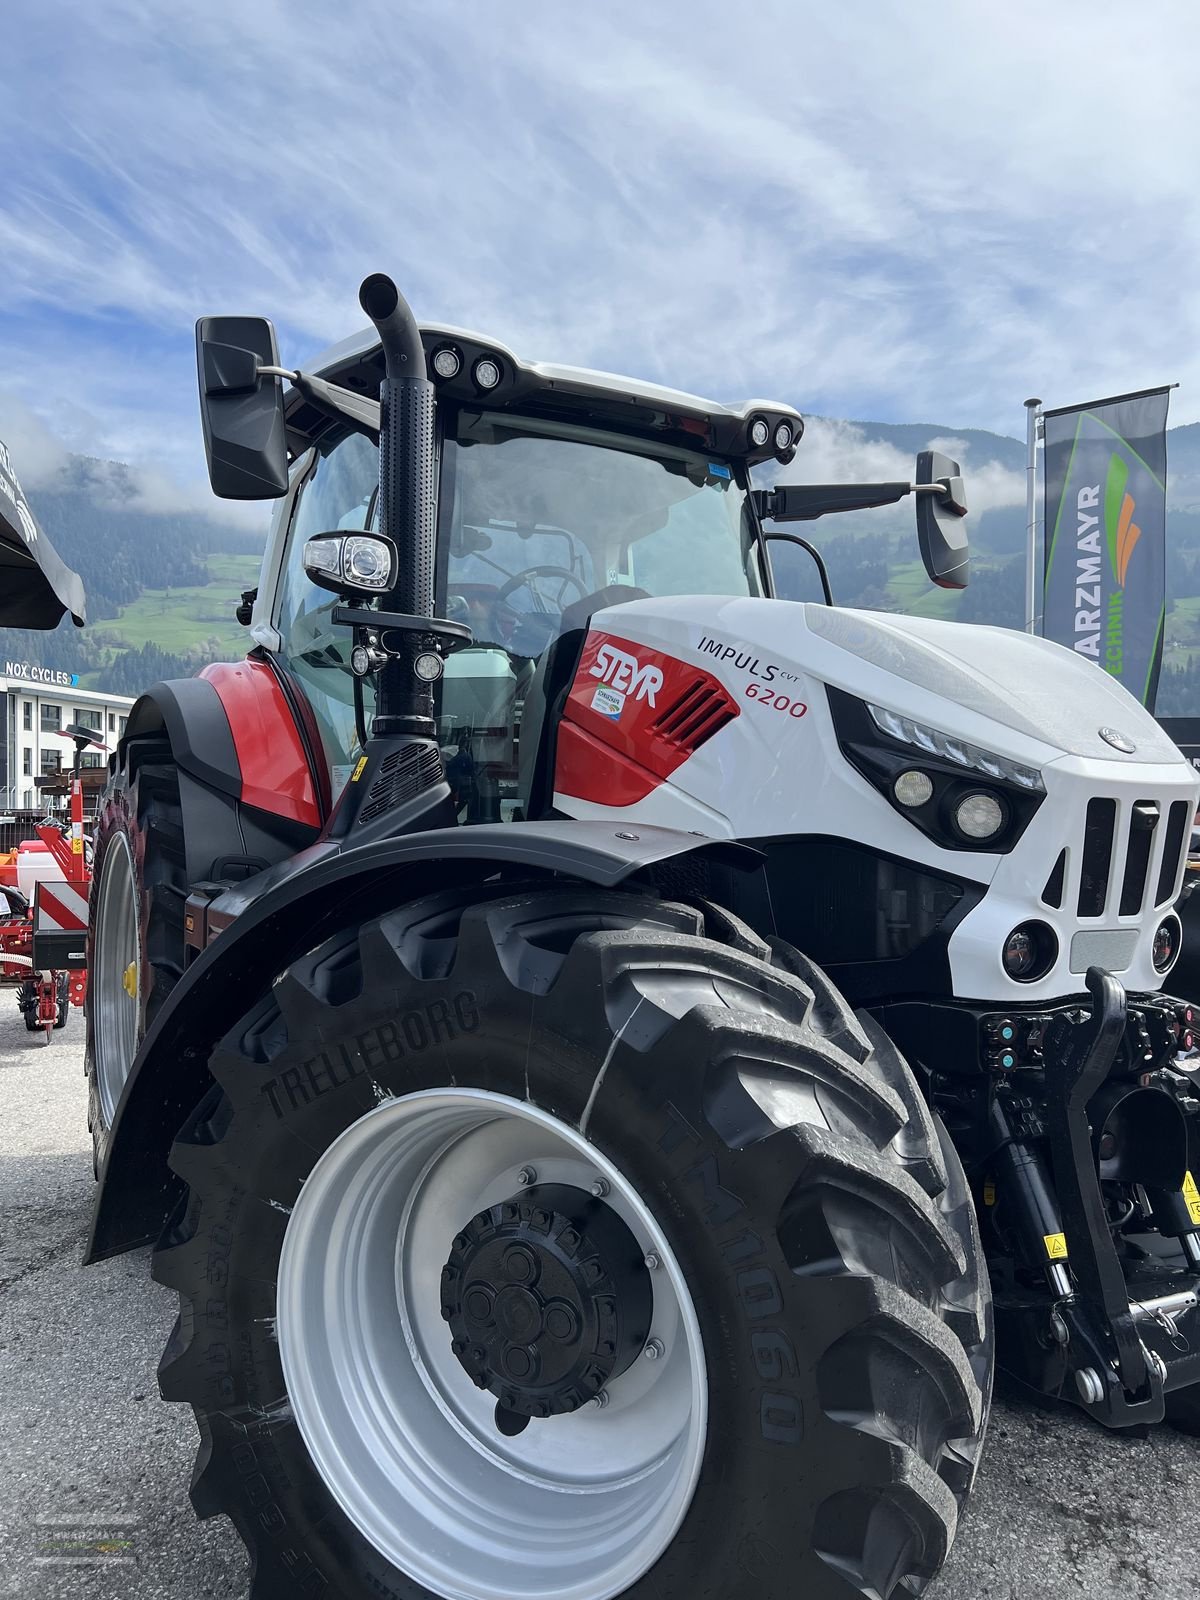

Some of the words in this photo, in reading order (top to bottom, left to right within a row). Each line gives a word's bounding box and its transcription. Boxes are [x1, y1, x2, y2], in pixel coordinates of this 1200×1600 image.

[1074, 484, 1103, 666] ARZMAYR
[6, 661, 28, 678] NOX
[31, 666, 68, 685] CYCLES
[589, 643, 664, 709] STEYR
[697, 636, 780, 682] IMPULS
[781, 671, 801, 683] CVT
[745, 683, 808, 719] 6200
[260, 990, 480, 1120] TRELLEBORG
[656, 1100, 804, 1446] TM1060
